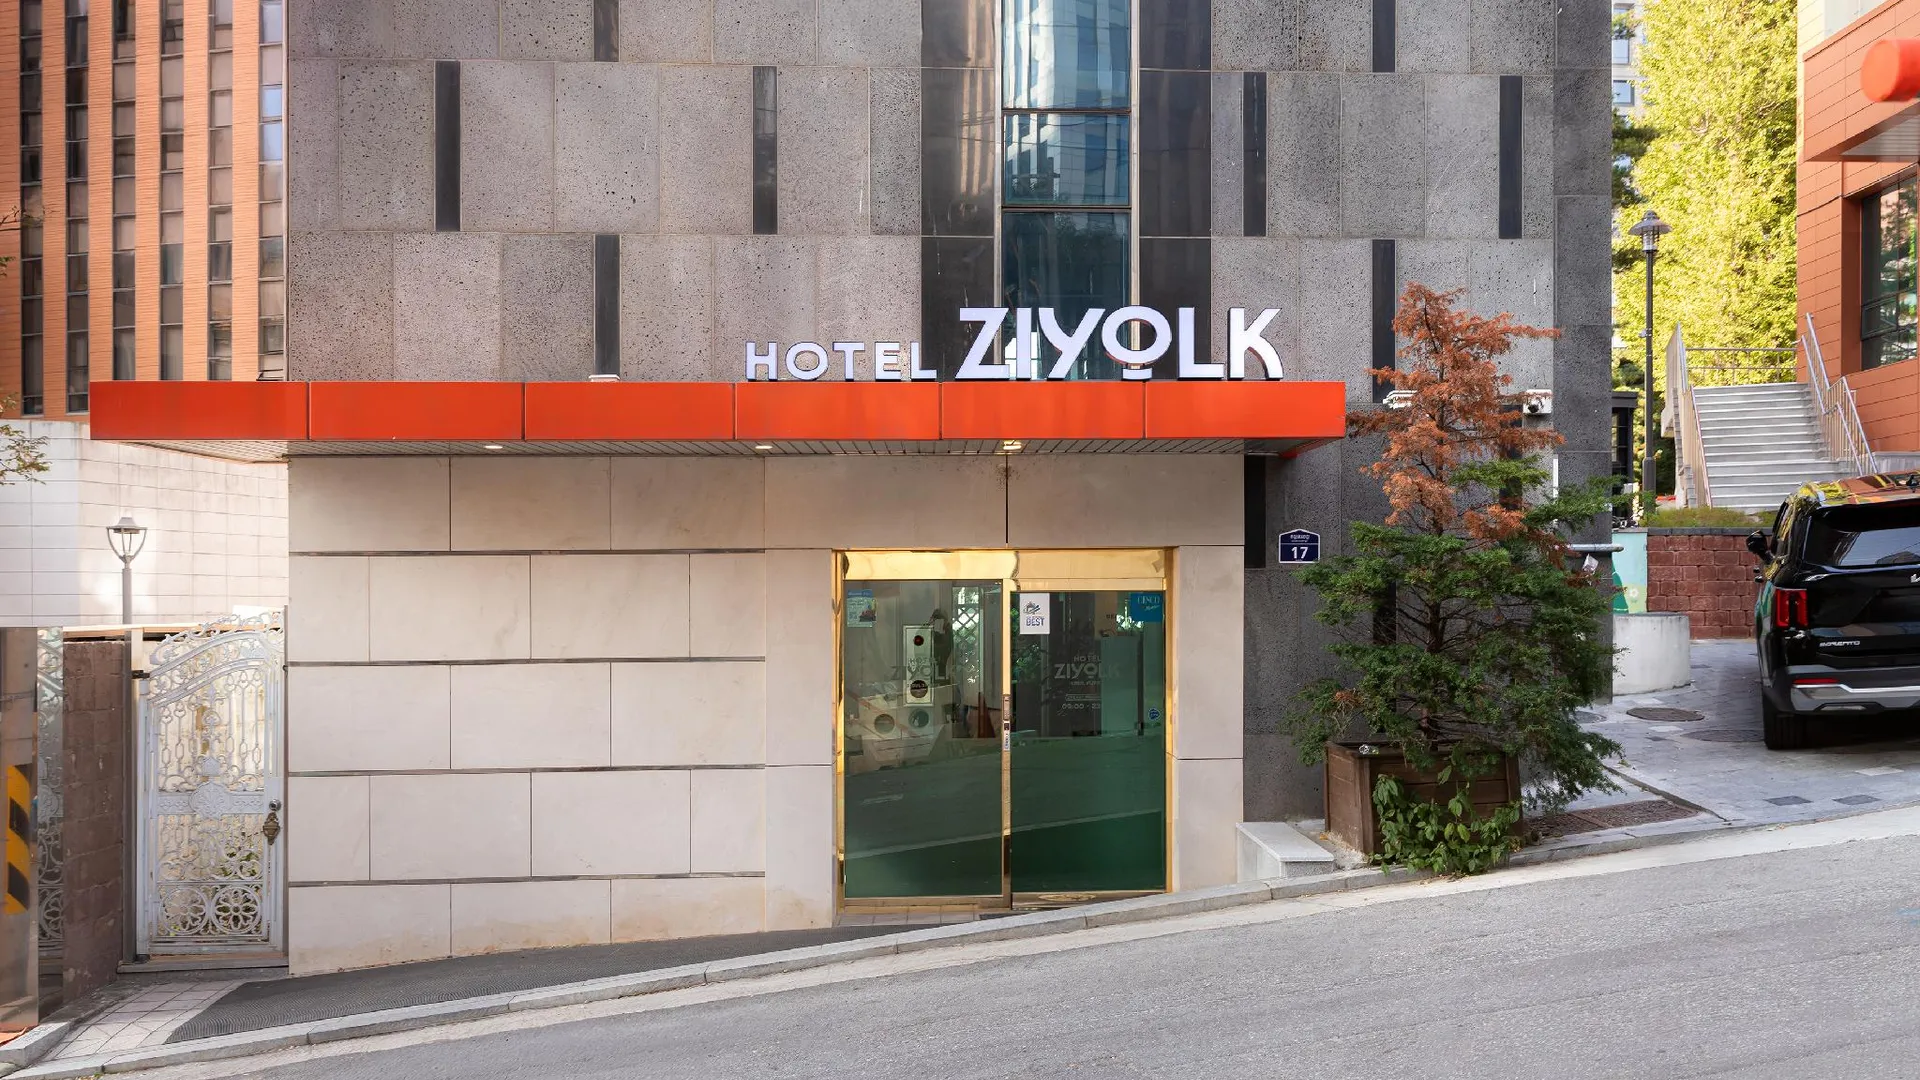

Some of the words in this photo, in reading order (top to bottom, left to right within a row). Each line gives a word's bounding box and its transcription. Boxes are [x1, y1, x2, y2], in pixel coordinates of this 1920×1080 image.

[745, 341, 937, 382] HOTEL
[954, 305, 1284, 380] ZIYOLK
[1291, 546, 1308, 559] 17
[1026, 616, 1045, 626] BEST
[1054, 662, 1120, 679] ZIYOLK
